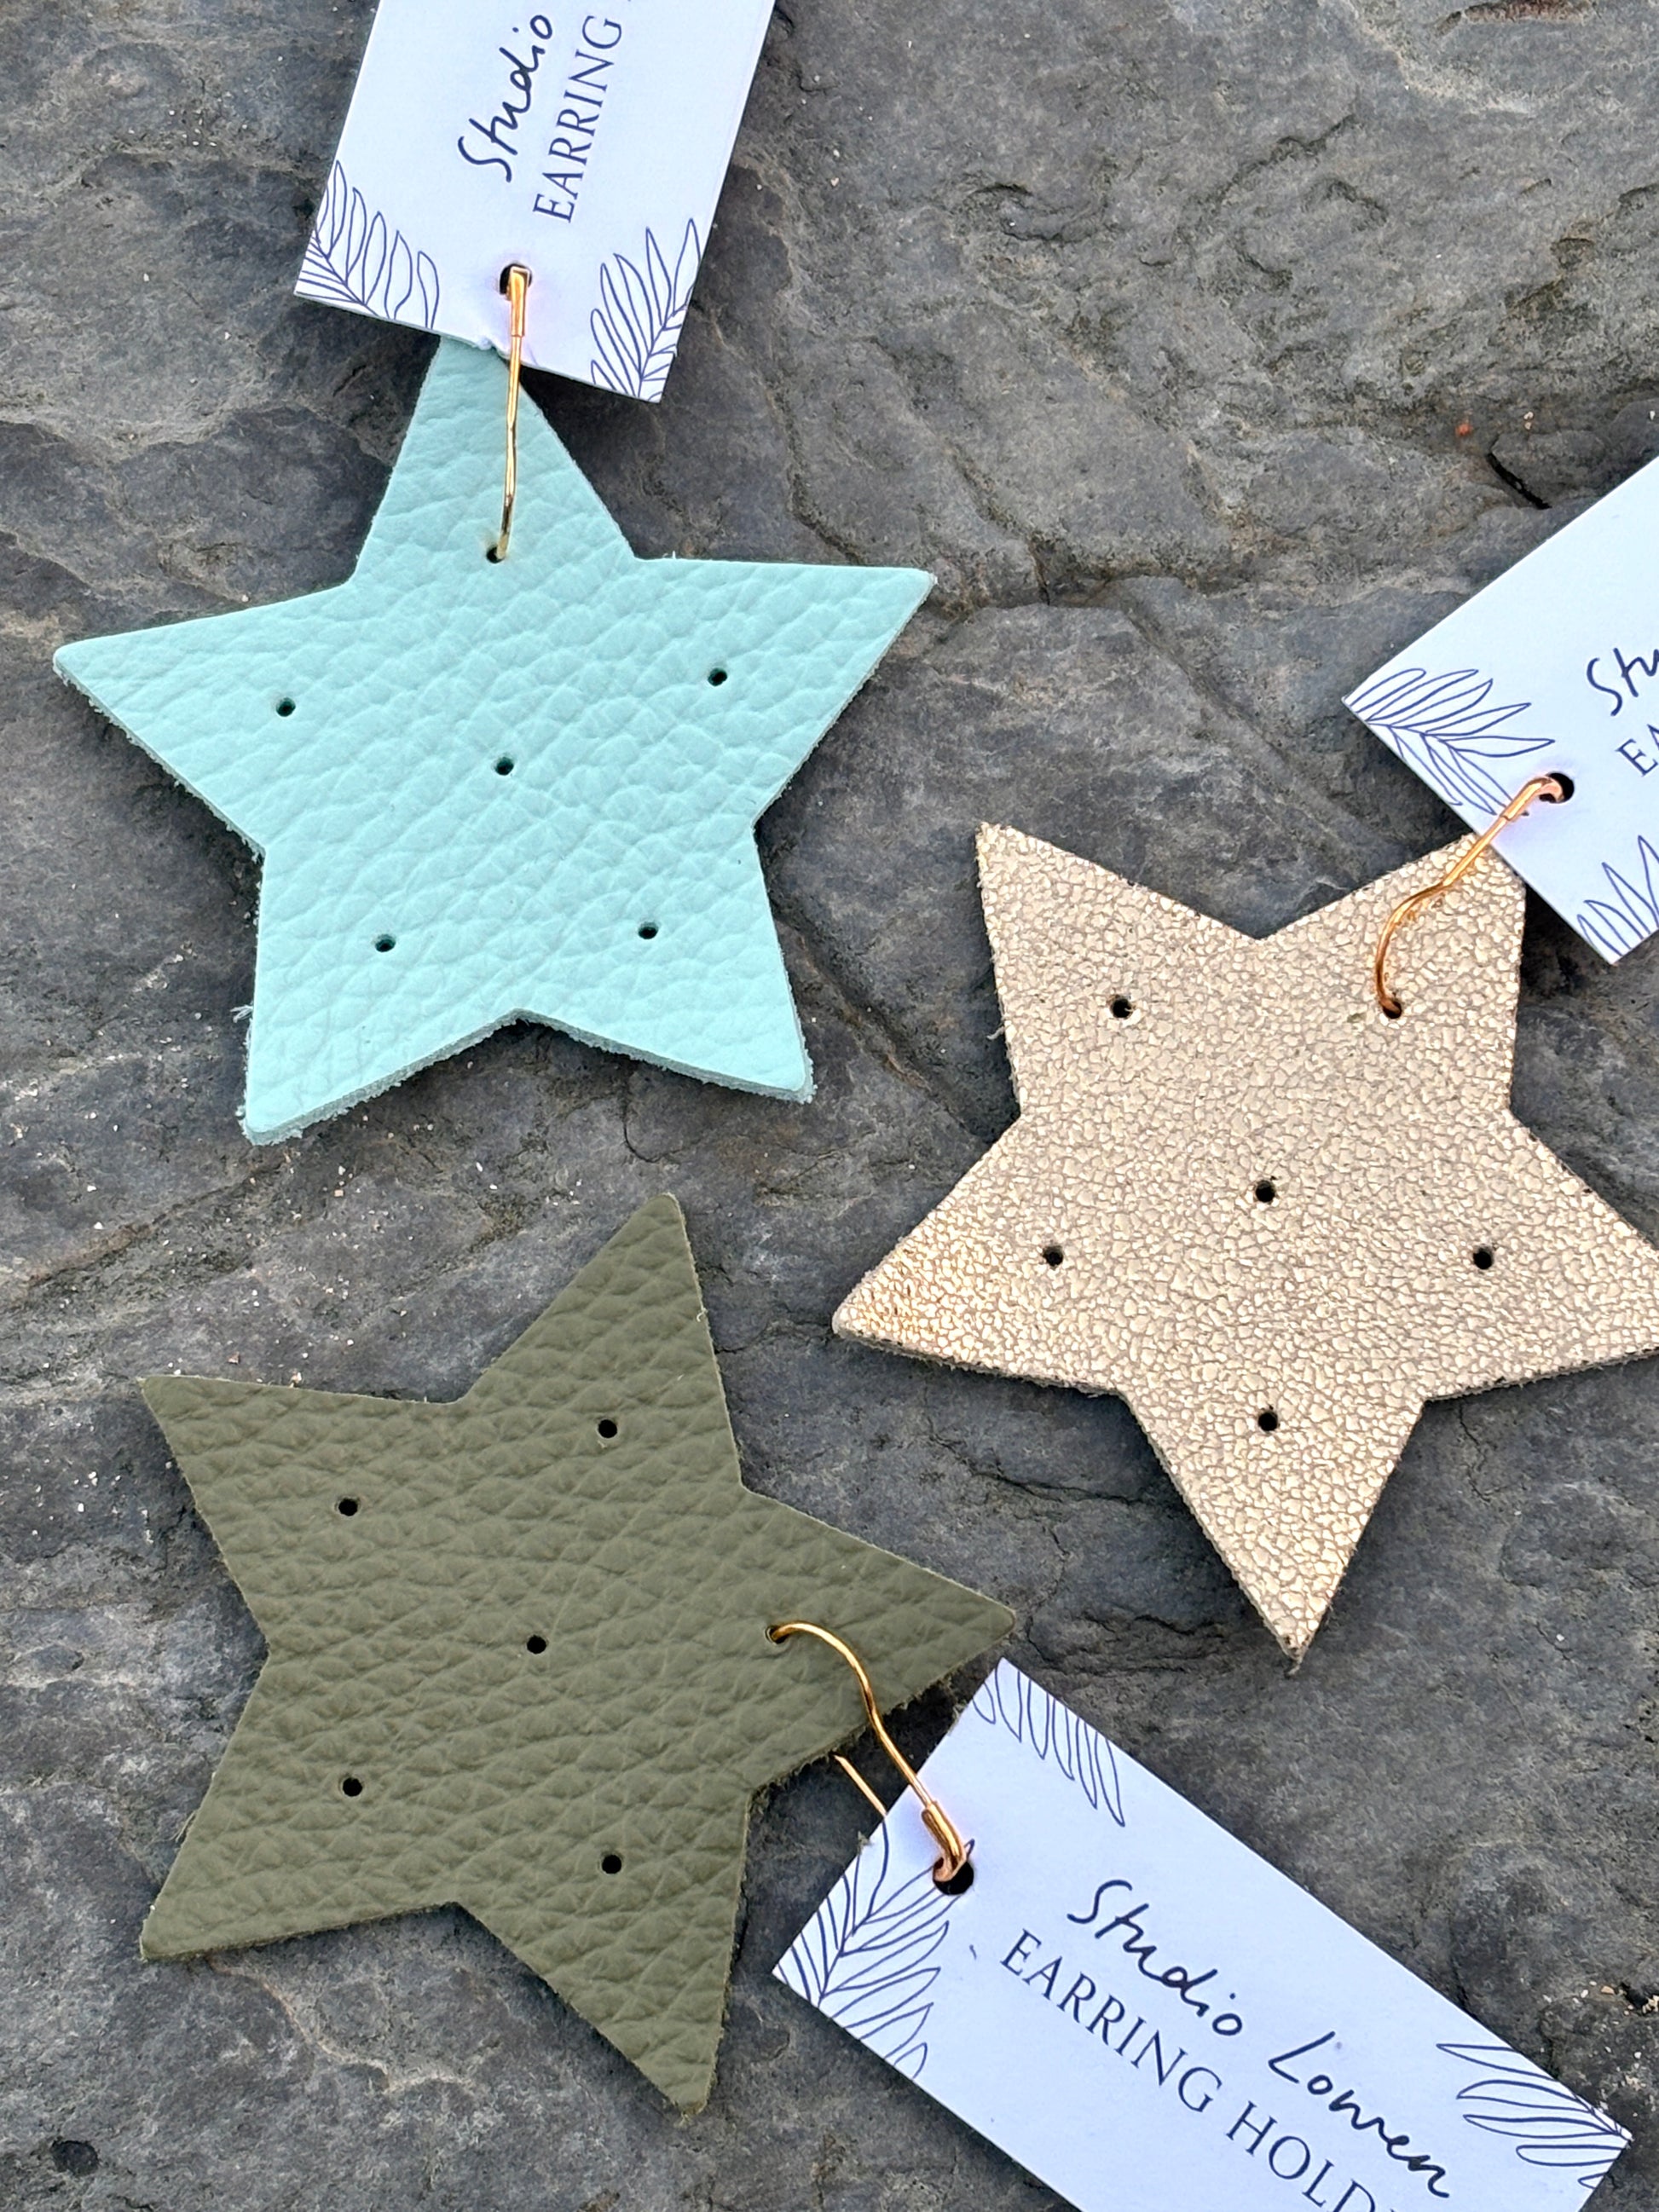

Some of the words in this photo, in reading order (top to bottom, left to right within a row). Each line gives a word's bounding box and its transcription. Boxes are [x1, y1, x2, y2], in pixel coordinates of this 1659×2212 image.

[458, 14, 552, 182] Studio
[533, 14, 622, 223] EARRING
[1066, 1879, 1243, 2036] Studio
[1000, 1928, 1223, 2112] EARRING
[1225, 2100, 1396, 2212] HOLD
